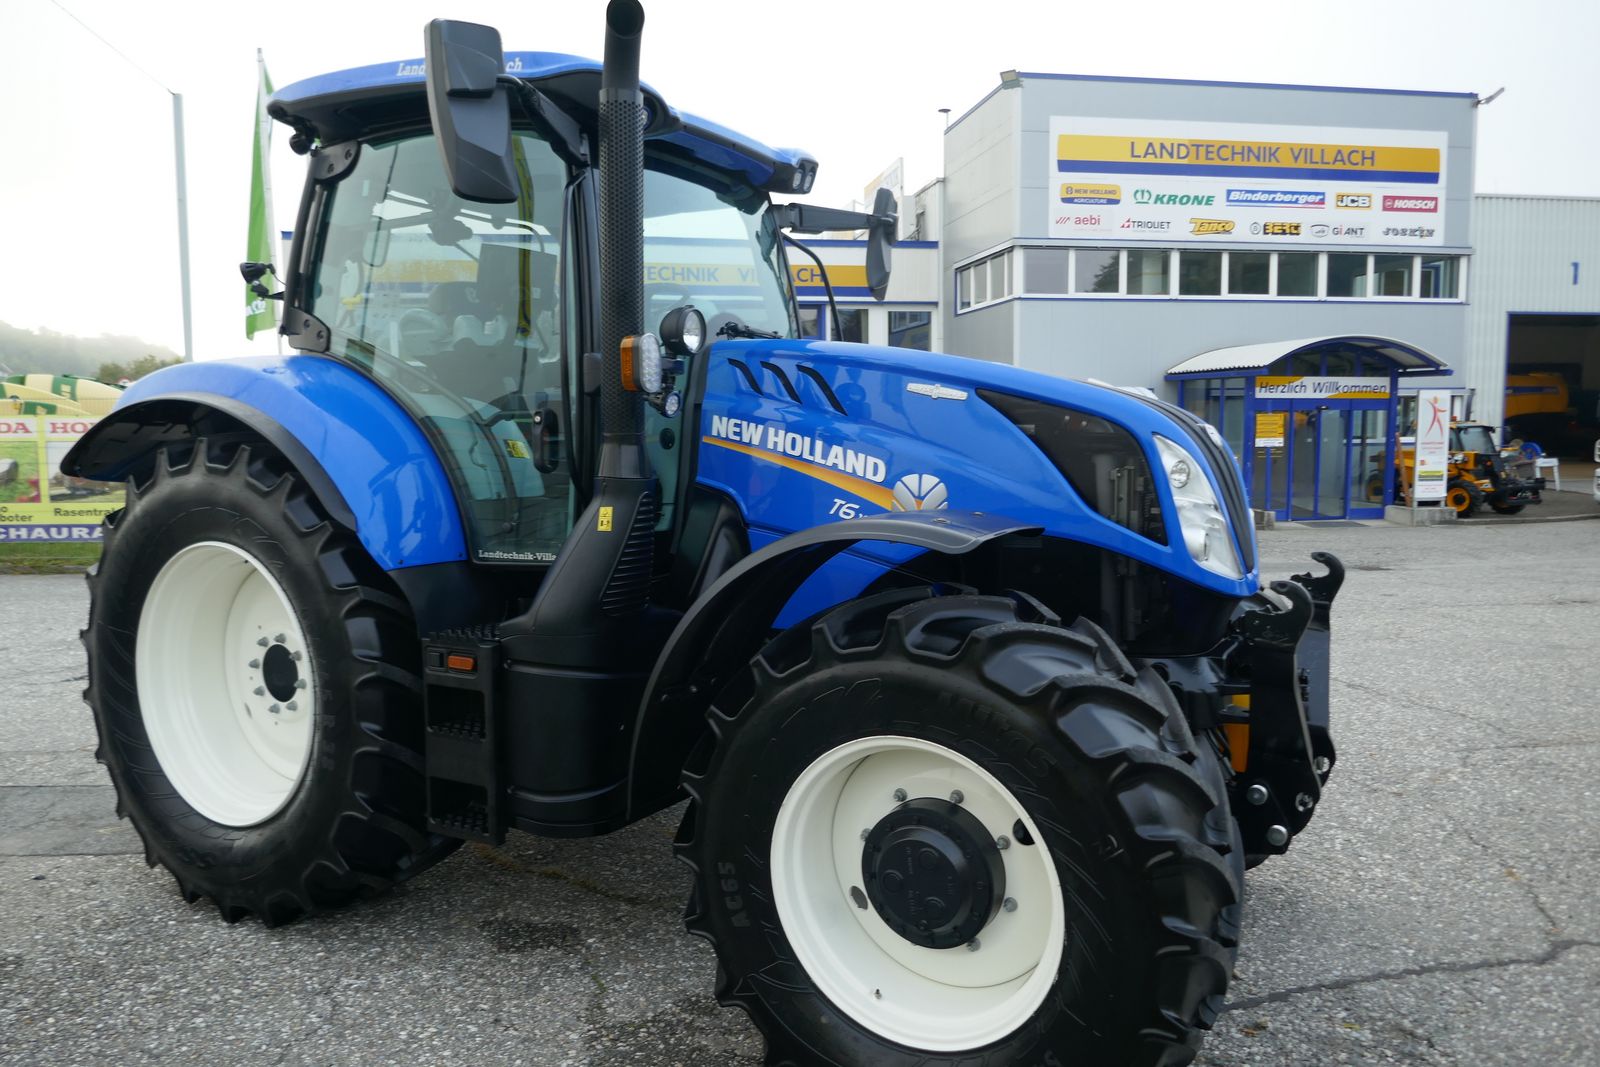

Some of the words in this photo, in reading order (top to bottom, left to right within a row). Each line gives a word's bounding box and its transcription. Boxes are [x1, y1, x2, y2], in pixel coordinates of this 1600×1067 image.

[1130, 141, 1281, 163] LANDTECHNIK
[1290, 147, 1376, 167] VILLACH
[1153, 193, 1216, 207] KRONE
[1228, 190, 1324, 205] Binderberger
[1336, 195, 1370, 208] JCB
[1393, 199, 1436, 210] HORSCH
[1073, 214, 1102, 226] aebi
[1190, 218, 1235, 234] Tanco
[645, 265, 719, 282] ECHNIK
[1258, 382, 1306, 394] Herzlich
[1312, 382, 1387, 394] Willkommen
[0, 422, 33, 434] DA
[49, 422, 97, 434] HO
[711, 415, 764, 446] NEW
[766, 426, 887, 483] HOLLAND
